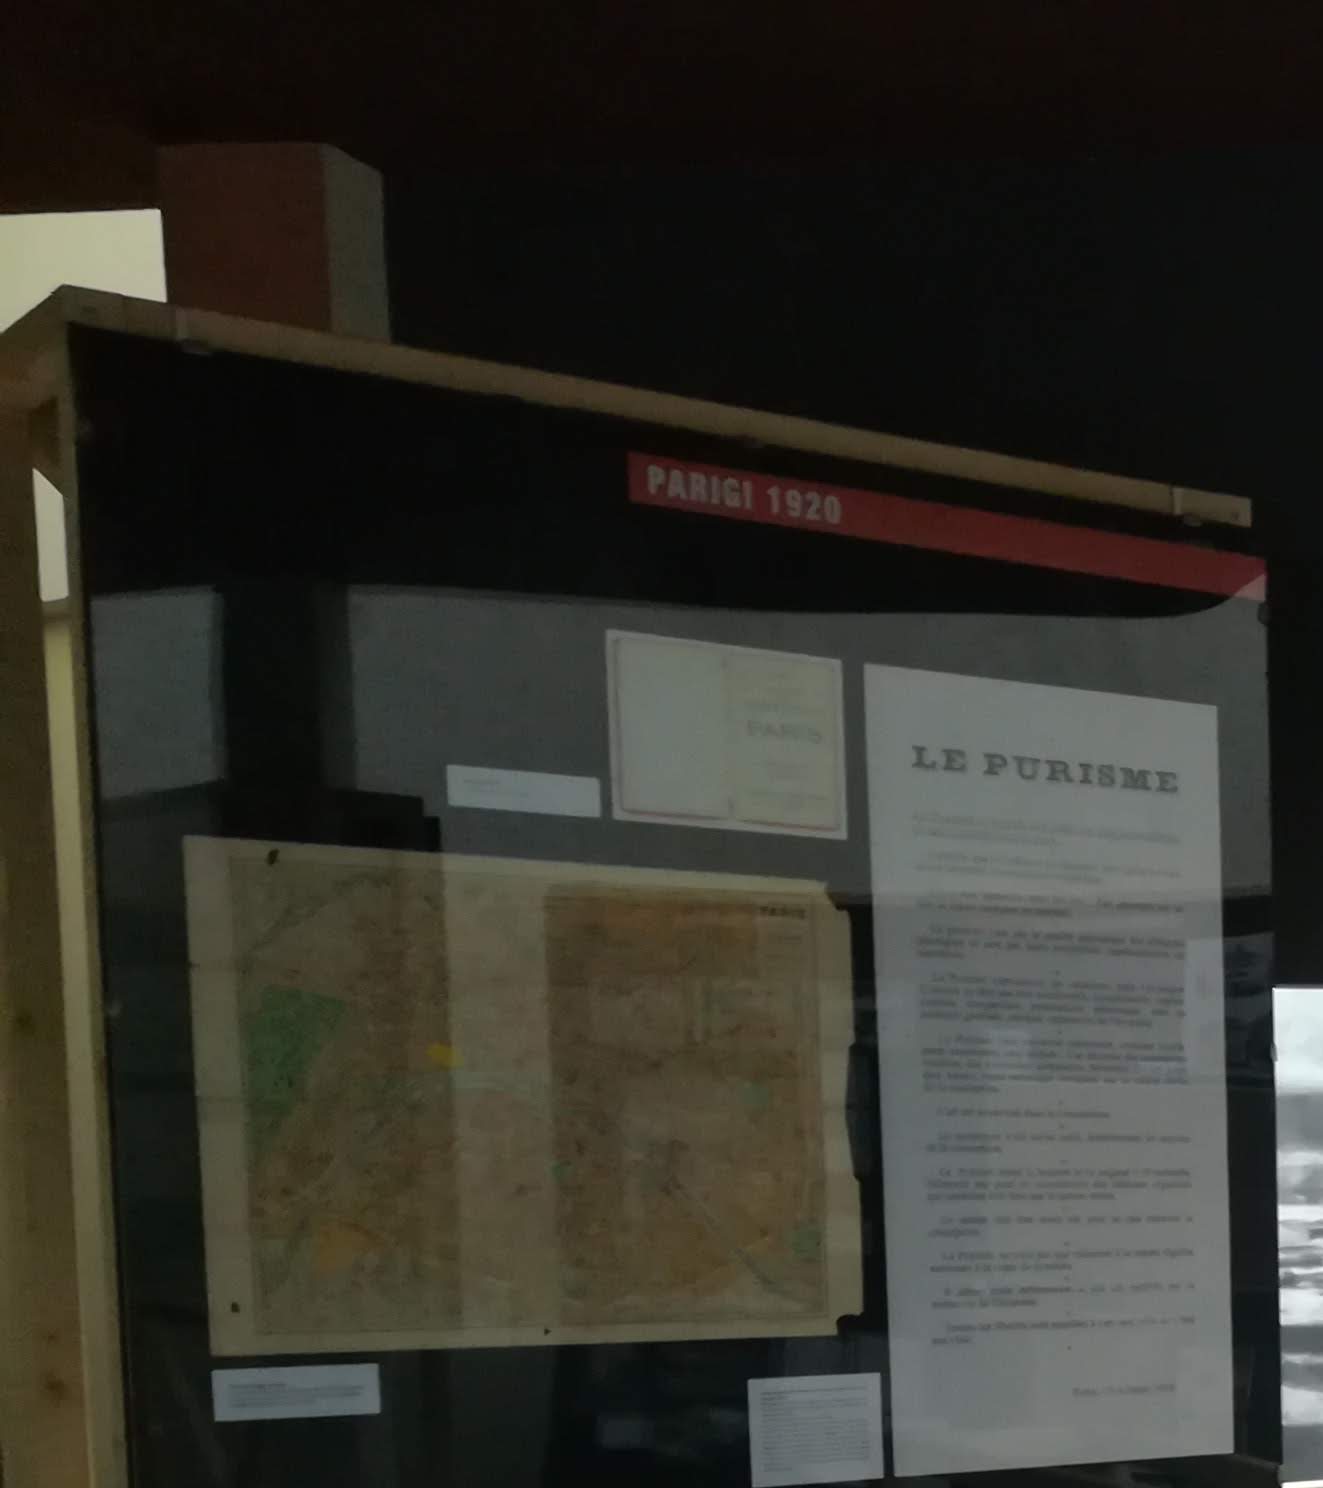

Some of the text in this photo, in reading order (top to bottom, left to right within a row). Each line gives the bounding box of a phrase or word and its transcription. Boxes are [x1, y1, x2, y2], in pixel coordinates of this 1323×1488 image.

[646, 464, 842, 524] PARIGI 1920
[911, 744, 1180, 794] LE PURISME
